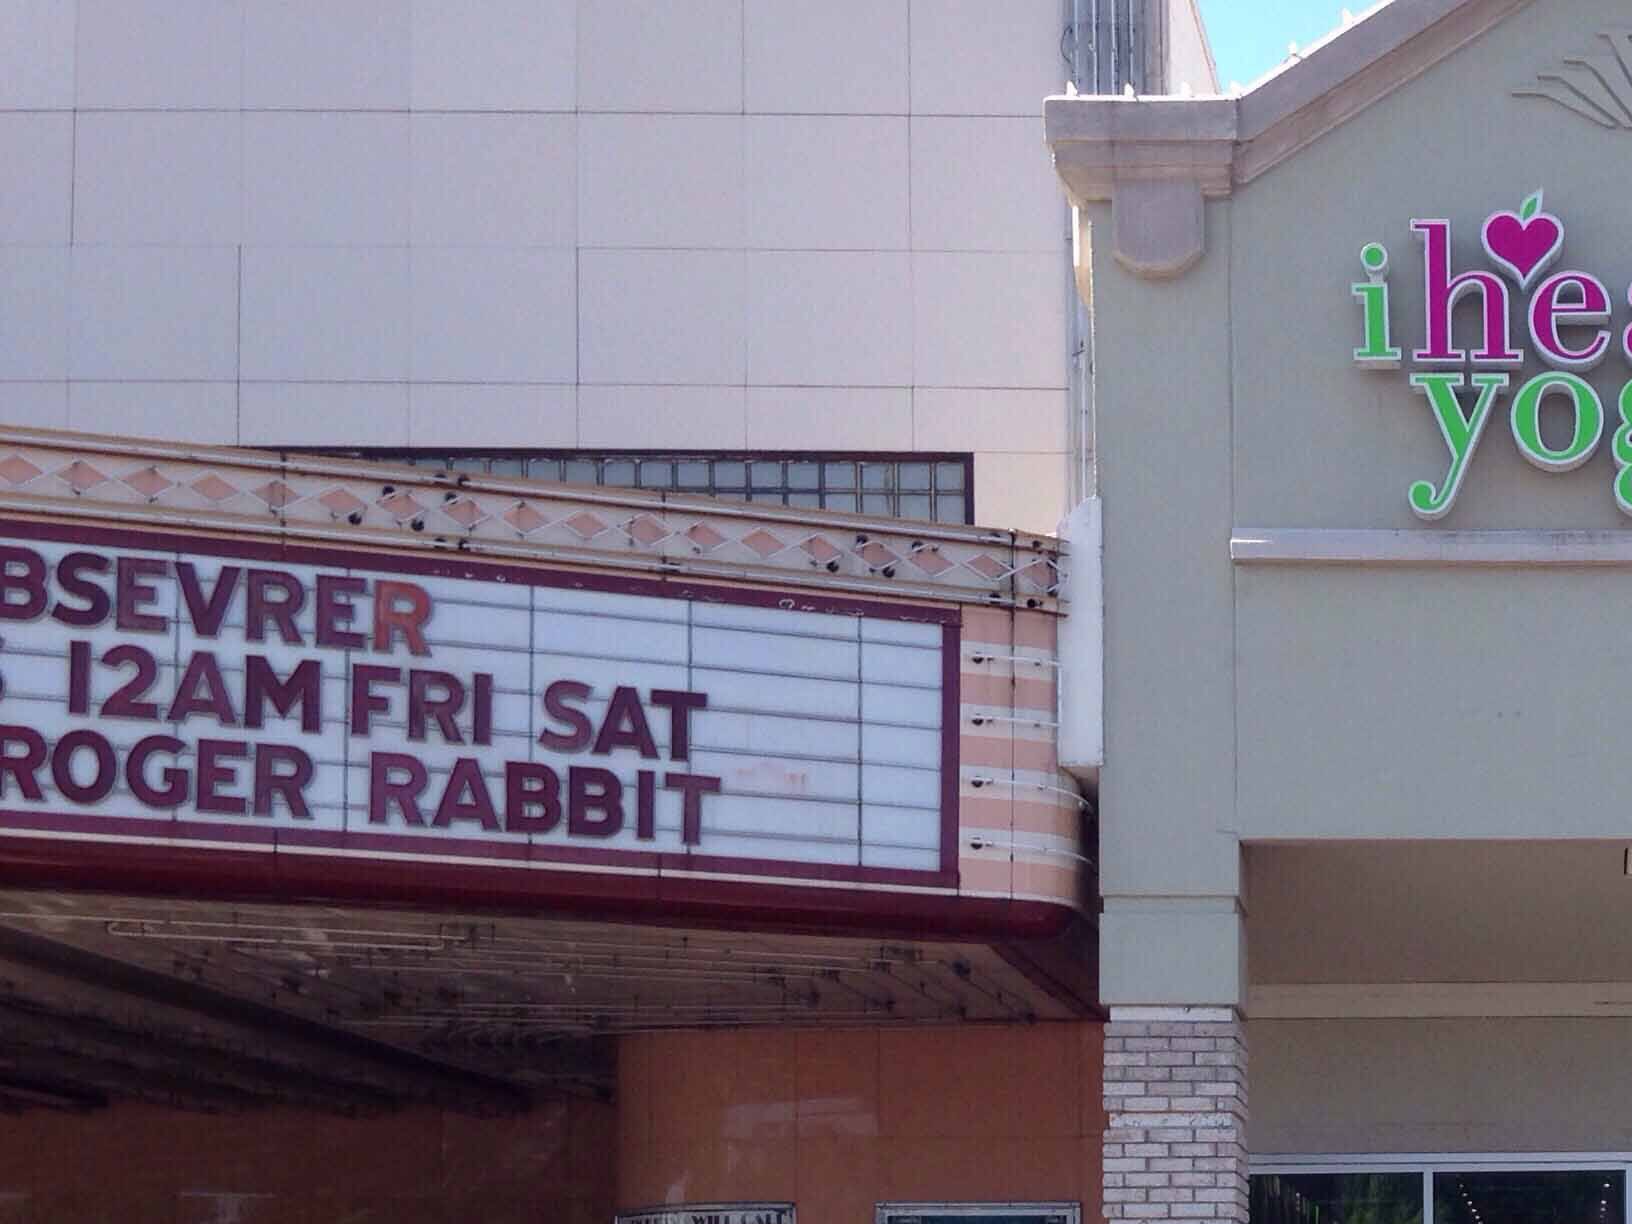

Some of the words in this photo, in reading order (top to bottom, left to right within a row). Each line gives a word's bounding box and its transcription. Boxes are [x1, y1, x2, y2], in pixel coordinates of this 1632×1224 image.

[351, 663, 493, 745] FRI
[538, 680, 708, 761] SAT
[0, 725, 315, 820] ROGER
[369, 751, 721, 845] RABBIT
